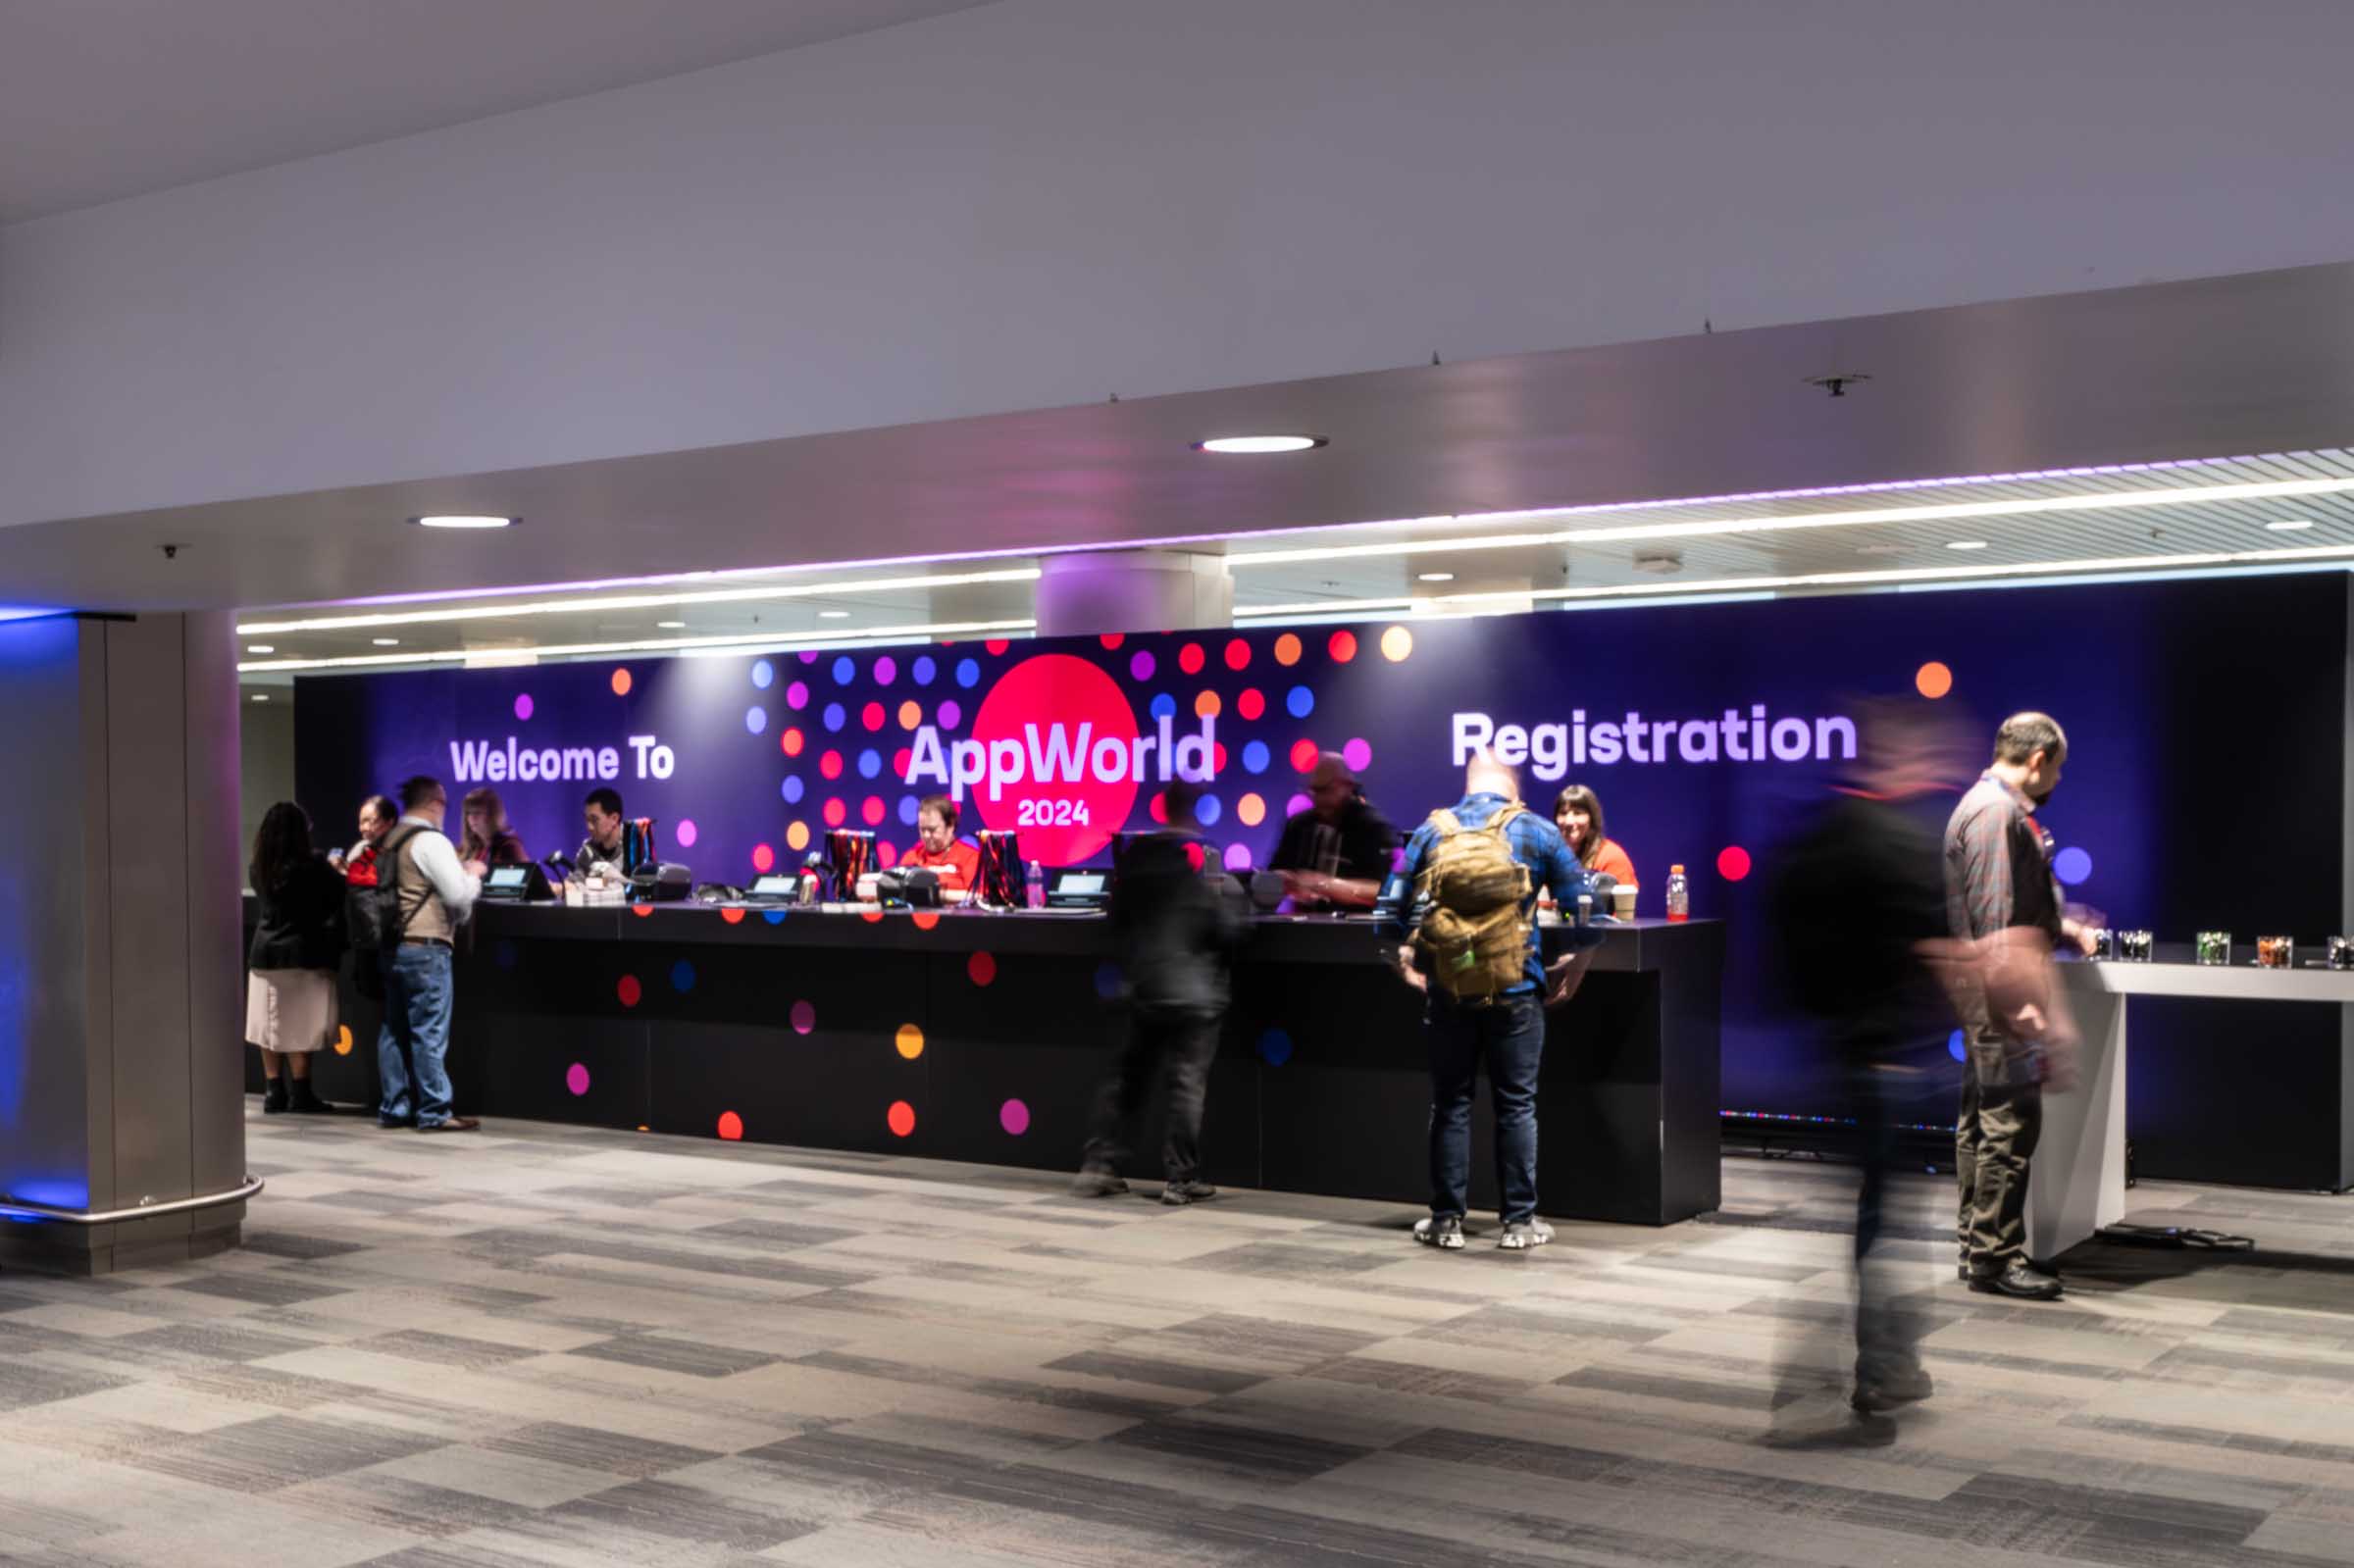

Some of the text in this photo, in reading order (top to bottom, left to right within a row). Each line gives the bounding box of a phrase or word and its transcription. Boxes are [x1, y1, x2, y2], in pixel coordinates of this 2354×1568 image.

[450, 735, 675, 782] Welcome To
[905, 714, 1215, 801] AppWorld
[1453, 705, 1857, 781] Registration
[1018, 798, 1090, 826] 2024
